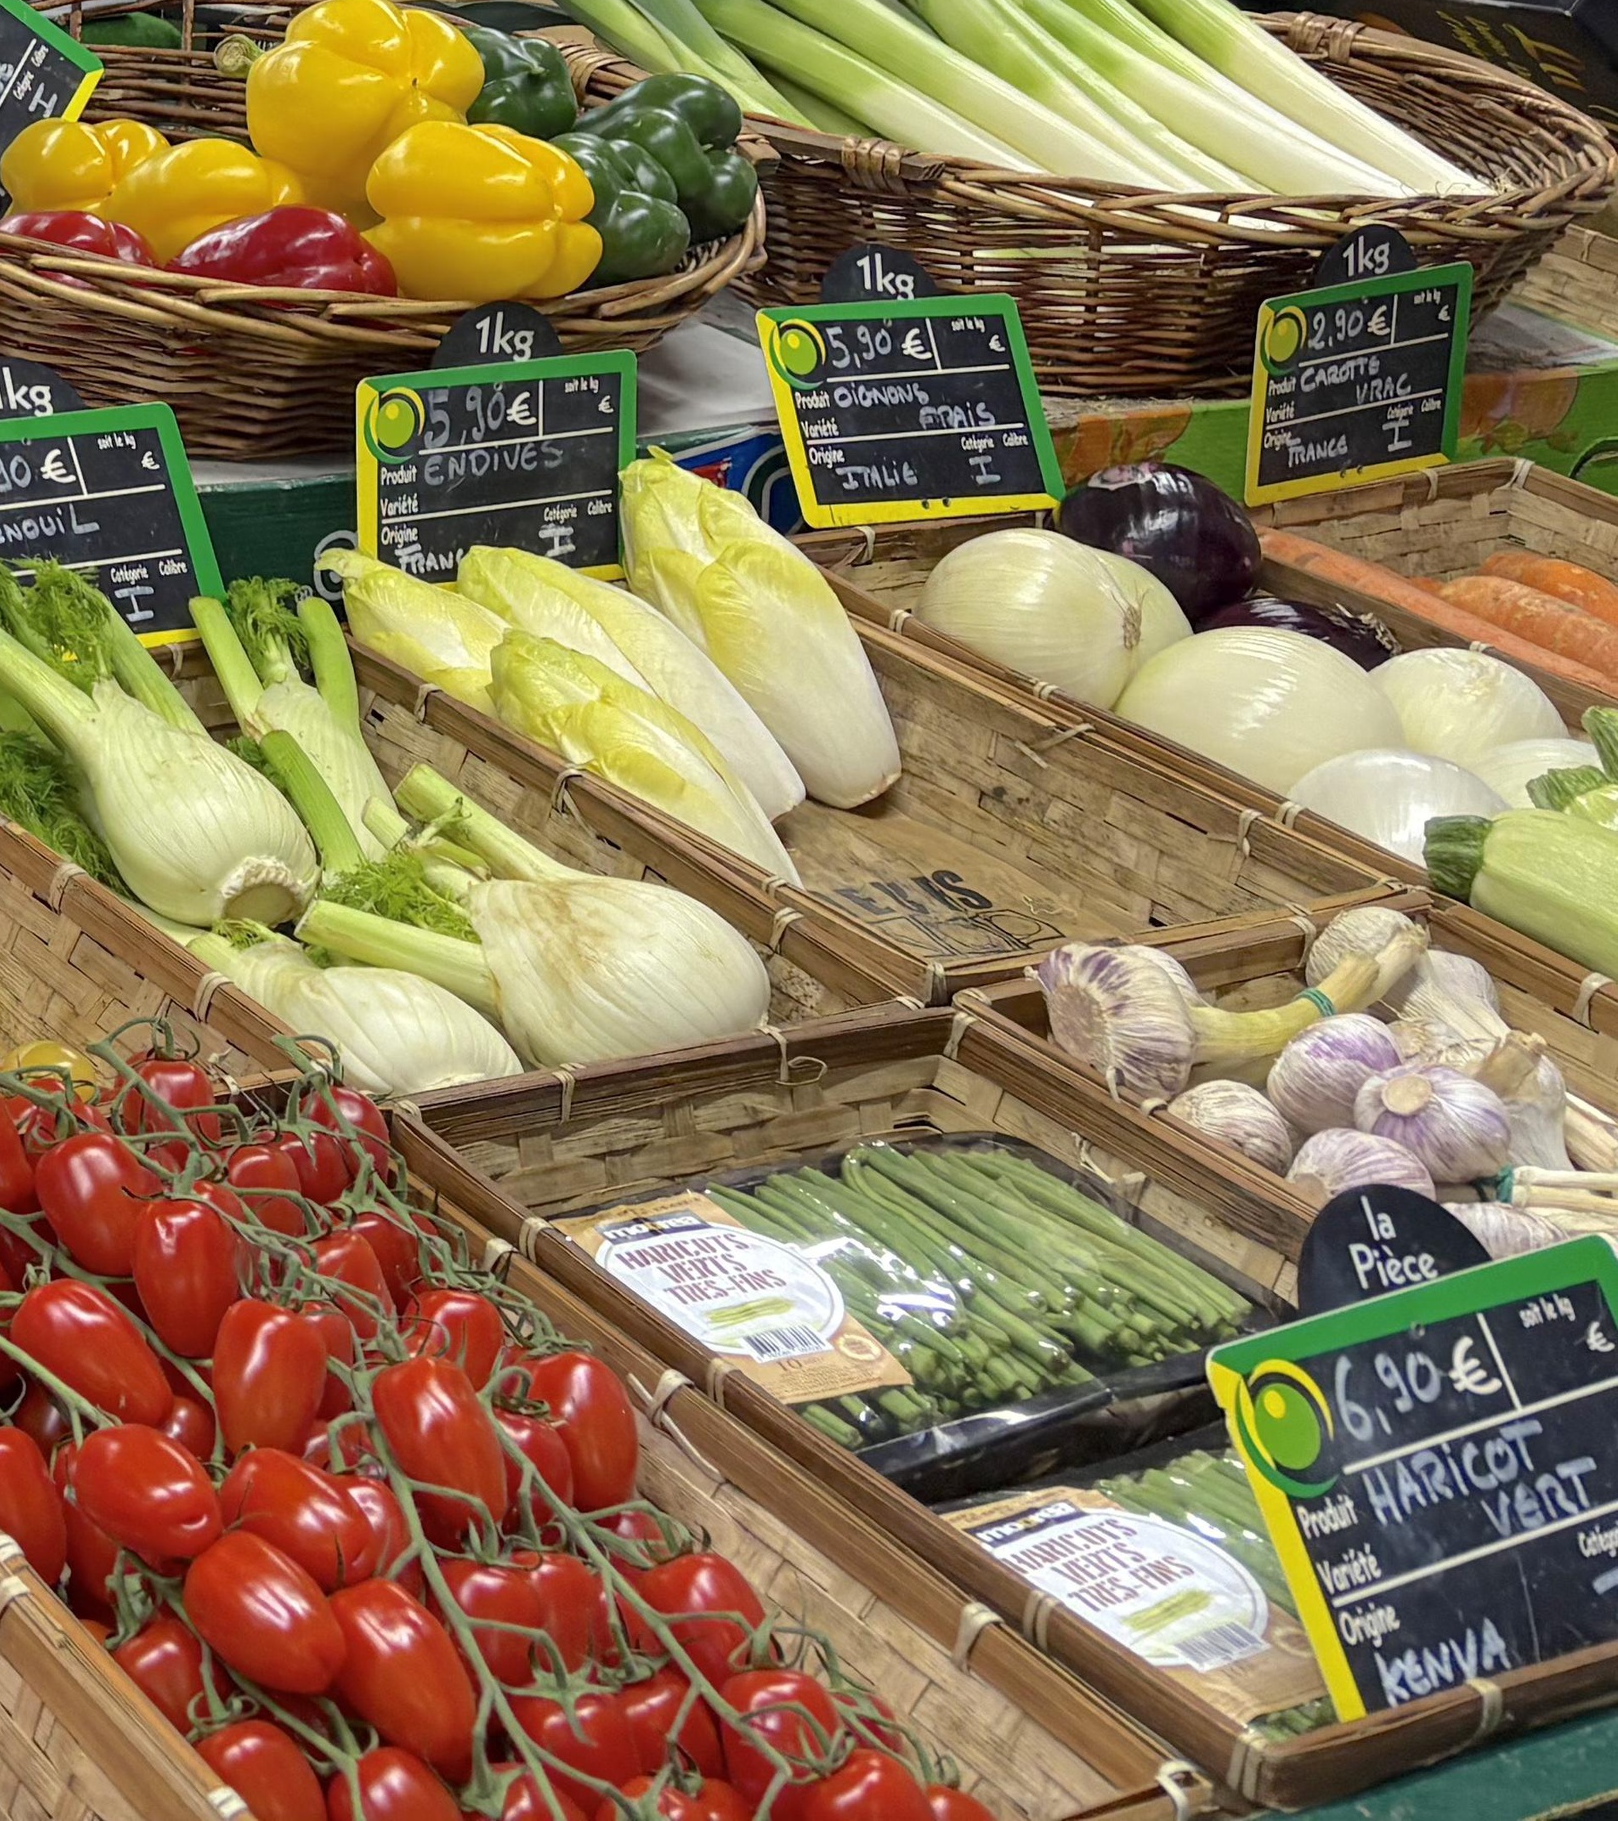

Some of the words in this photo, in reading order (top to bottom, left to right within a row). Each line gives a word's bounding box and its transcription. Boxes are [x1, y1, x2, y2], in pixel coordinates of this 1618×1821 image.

[856, 252, 915, 301] 1kg
[1342, 235, 1390, 277] 1kg
[826, 325, 893, 370] 5,90
[1309, 307, 1363, 351] 2,90
[1367, 304, 1391, 336] €
[833, 380, 930, 408] OIGNONS
[1300, 355, 1381, 393] CAROTTE
[1355, 372, 1412, 406] VRAC
[423, 384, 506, 449] 5,90
[795, 390, 831, 410] Produit
[918, 401, 996, 430] FRAIS
[800, 418, 840, 438] Variété
[423, 440, 563, 486] ENDIVES
[808, 447, 846, 468] Origine
[835, 459, 919, 490] ITALIE
[380, 492, 419, 515] Variété
[380, 525, 419, 548] Origine
[110, 566, 150, 585] Catégorie
[1360, 1195, 1398, 1242] la
[613, 1232, 751, 1271] HARICOTS
[657, 1253, 749, 1285] VERTS
[1348, 1242, 1440, 1291] Pièce
[663, 1268, 789, 1306] TRES-FINS
[1333, 1354, 1442, 1443] 6,90
[1361, 1419, 1544, 1528] HARICOT
[1296, 1493, 1359, 1542] Produit
[1480, 1456, 1599, 1538] VERT
[1000, 1517, 1138, 1576] HARICOTS
[1051, 1541, 1147, 1586] VERTS
[1067, 1555, 1195, 1613] TRES-FINS
[1315, 1545, 1383, 1596] Variété
[1337, 1602, 1402, 1650] Origine
